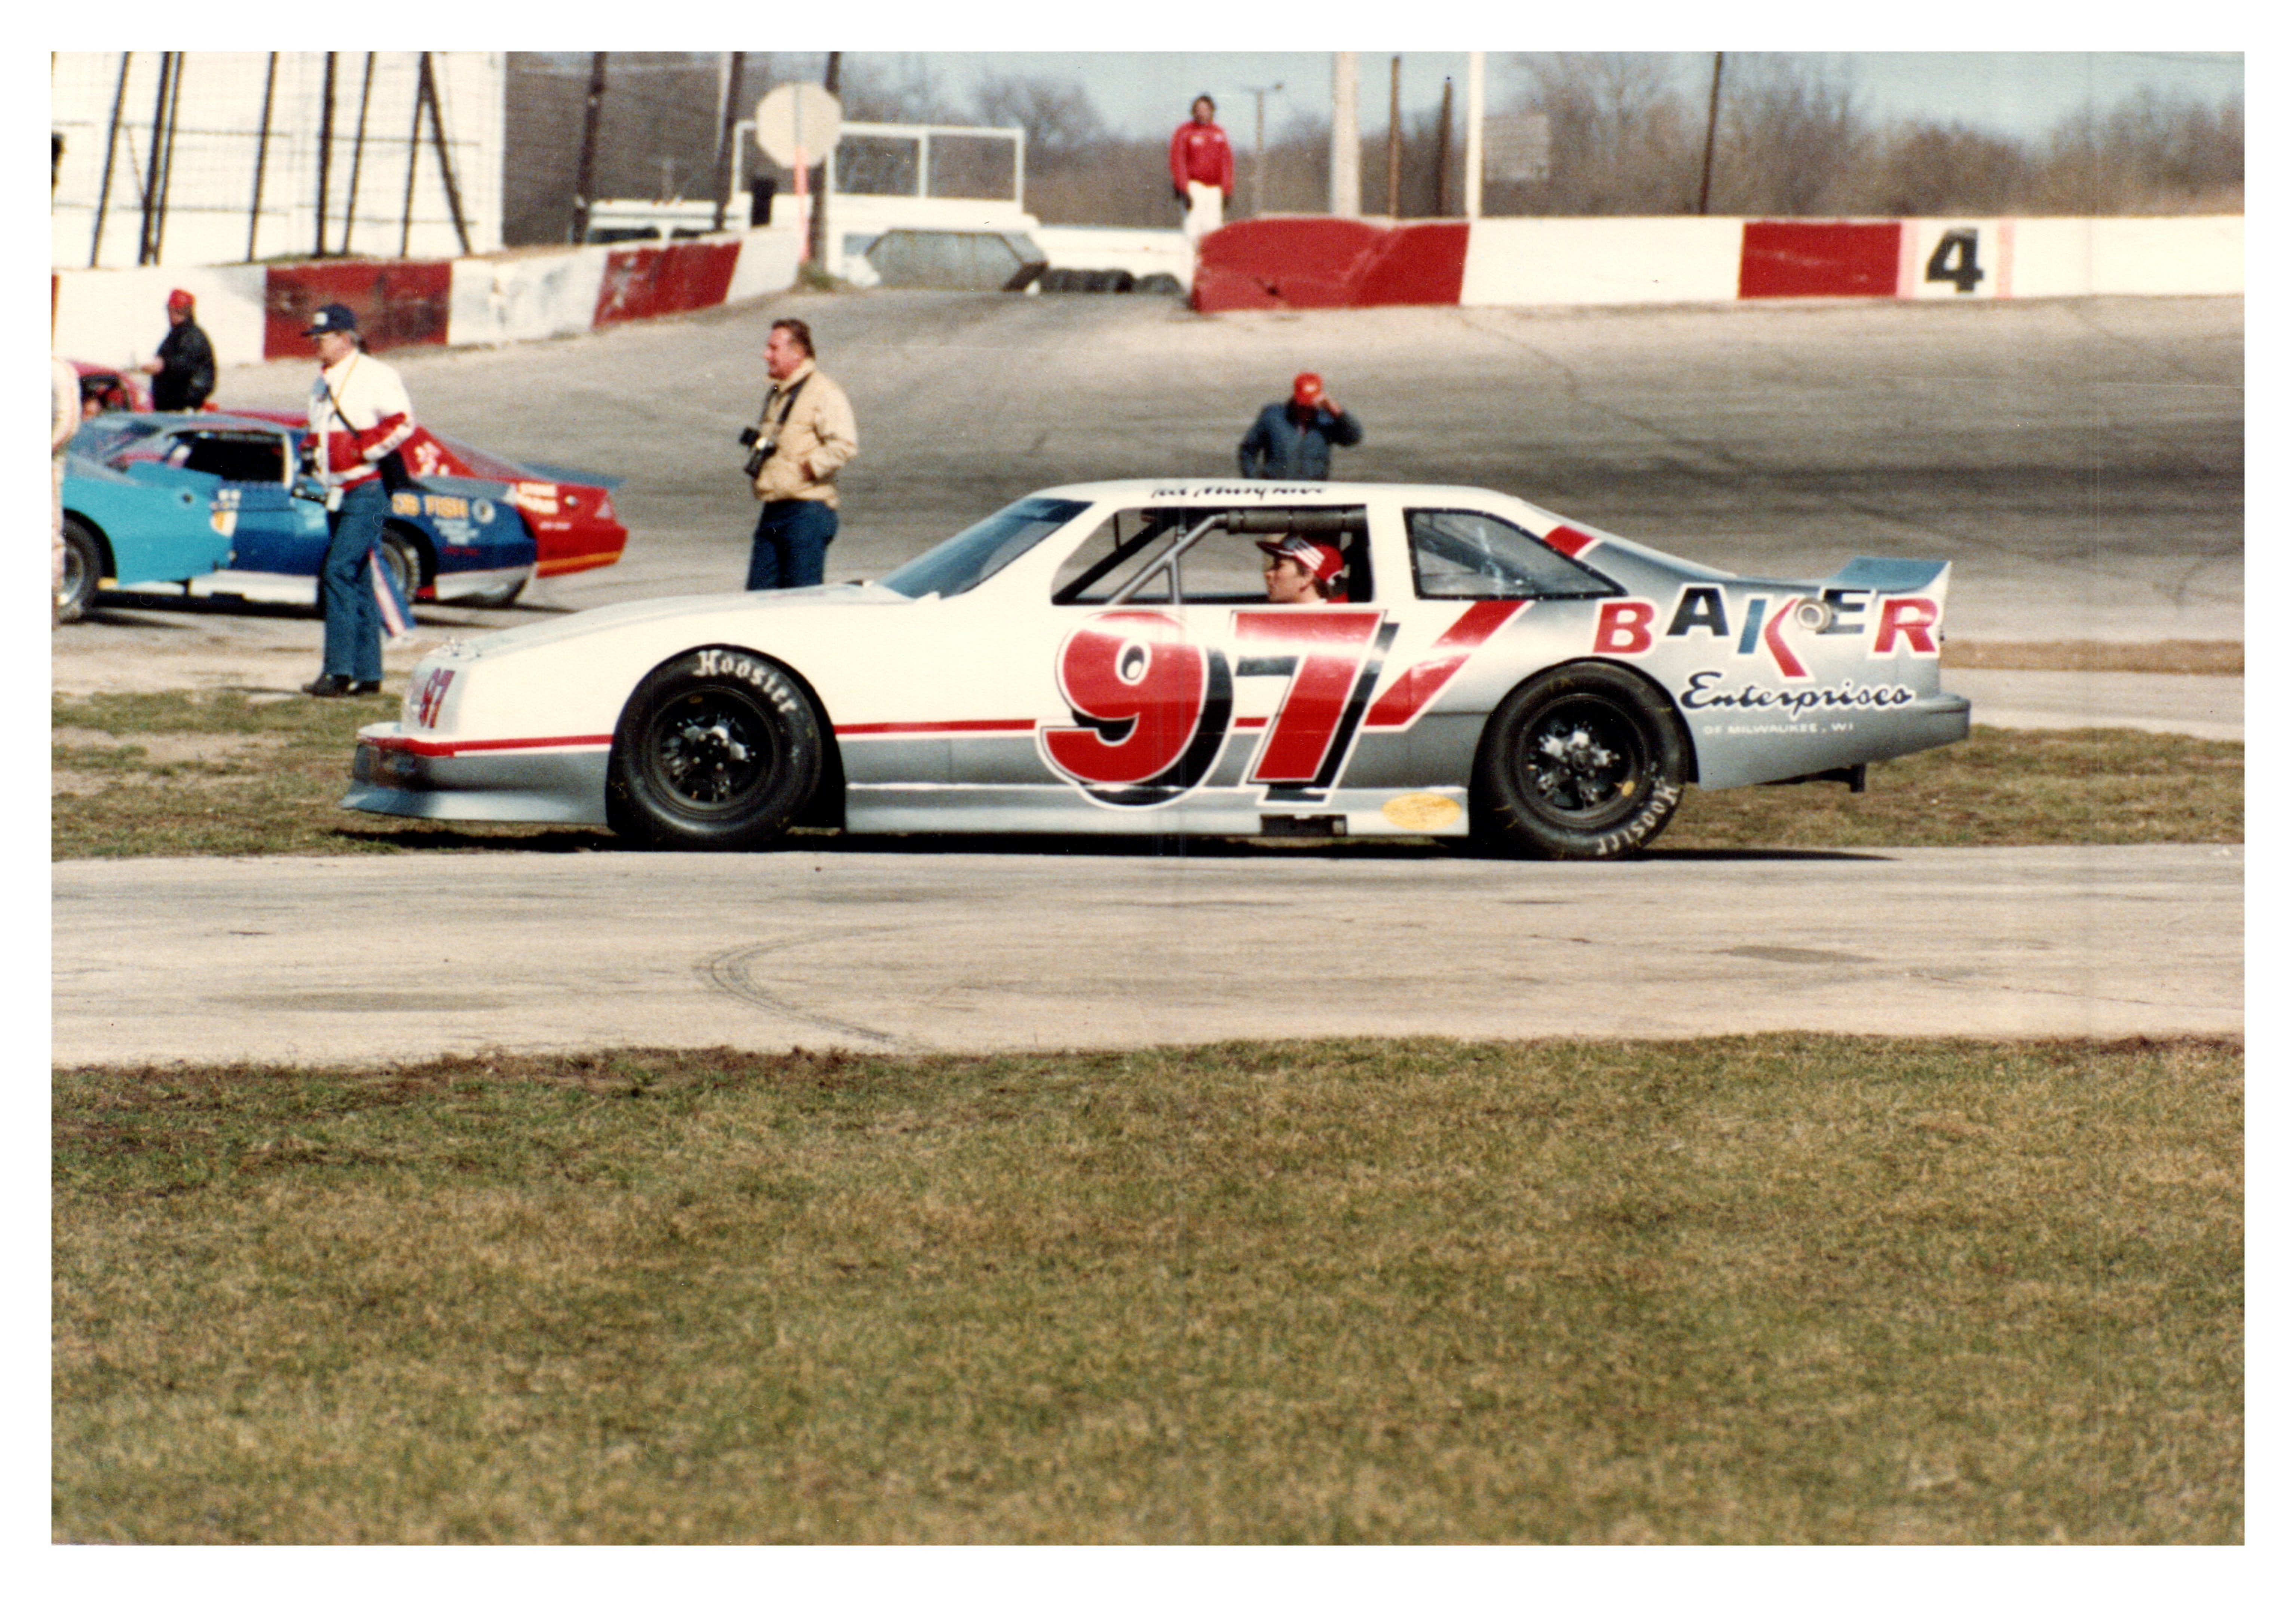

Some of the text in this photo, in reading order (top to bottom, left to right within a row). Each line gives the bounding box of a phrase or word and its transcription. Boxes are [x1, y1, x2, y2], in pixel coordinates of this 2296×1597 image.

[1926, 227, 1985, 293] 4
[1590, 584, 1940, 680] BAKER
[692, 649, 798, 713] Hoosier
[1035, 609, 1400, 810] 97
[1680, 671, 1914, 717] Enterprises
[1703, 725, 1721, 735] OF
[1831, 722, 1854, 732] WI
